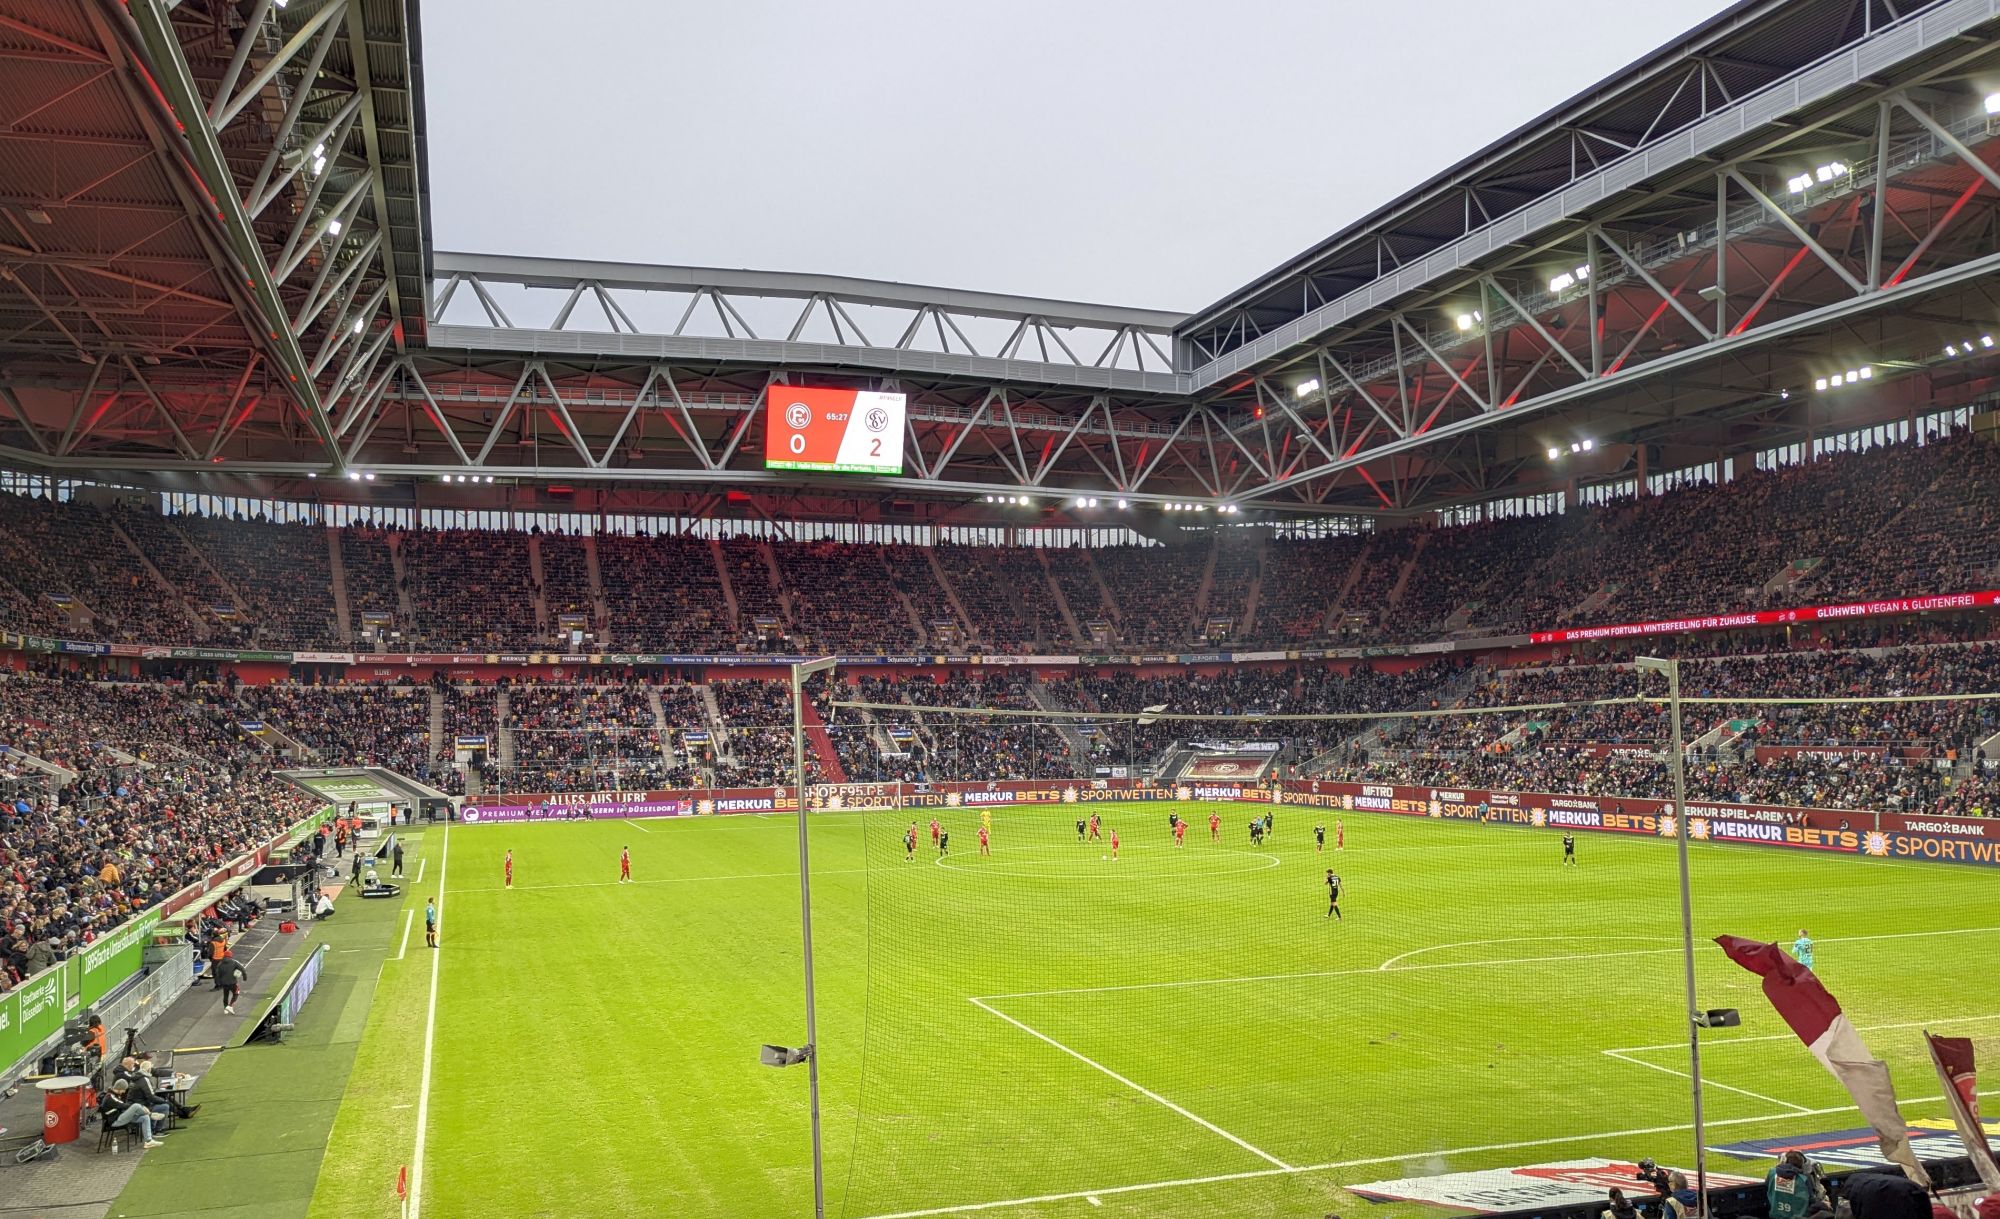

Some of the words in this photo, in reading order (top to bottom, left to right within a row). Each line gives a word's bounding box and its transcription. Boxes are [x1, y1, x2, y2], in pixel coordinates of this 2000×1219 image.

[826, 412, 848, 421] 65:27
[790, 433, 806, 454] 0
[870, 438, 882, 457] 2
[1817, 605, 1865, 618] GLÜHWEIN
[1868, 602, 1900, 613] VEGAN
[1902, 602, 1909, 611] &
[1911, 595, 1975, 610] GLUTENFREI
[1566, 631, 1579, 640] DAS
[1580, 628, 1610, 638] PREMIUM
[1611, 626, 1642, 636] FORTUNA
[1643, 620, 1701, 632] WINTERFEELING
[1702, 617, 1718, 628] FÜR
[1719, 614, 1759, 625] ZUHAUSE.
[174, 649, 188, 657] AOK
[200, 649, 214, 657] Lass
[226, 650, 239, 659] über
[964, 792, 1013, 802] MERKUR
[1016, 791, 1060, 800] BETS
[1081, 789, 1173, 800] SPORTWETTEN
[1194, 788, 1241, 797] MERKUR
[1242, 789, 1272, 799] BETS
[1363, 786, 1394, 797] METRO
[550, 794, 586, 805] ALLES
[590, 793, 613, 804] AUS
[617, 792, 648, 803] LIEBE
[717, 799, 772, 810] MERKUR
[774, 798, 824, 809] BETS
[847, 794, 943, 807] SPORTWETTEN
[1283, 792, 1341, 807] SPORTWETTEN
[1355, 797, 1390, 809] MERKUR
[1391, 799, 1427, 811] BETS
[628, 805, 676, 813] DÜSSELDORF
[1685, 806, 1718, 817] ERKUR
[1549, 810, 1600, 825] MERKUR
[1602, 813, 1656, 830] BETS
[1713, 821, 1782, 841] MERKUR
[1786, 827, 1858, 847] BETS
[22, 985, 45, 1007] Stadtwerke
[22, 997, 45, 1024] Düsseldorf
[1777, 1201, 1792, 1212] 39
